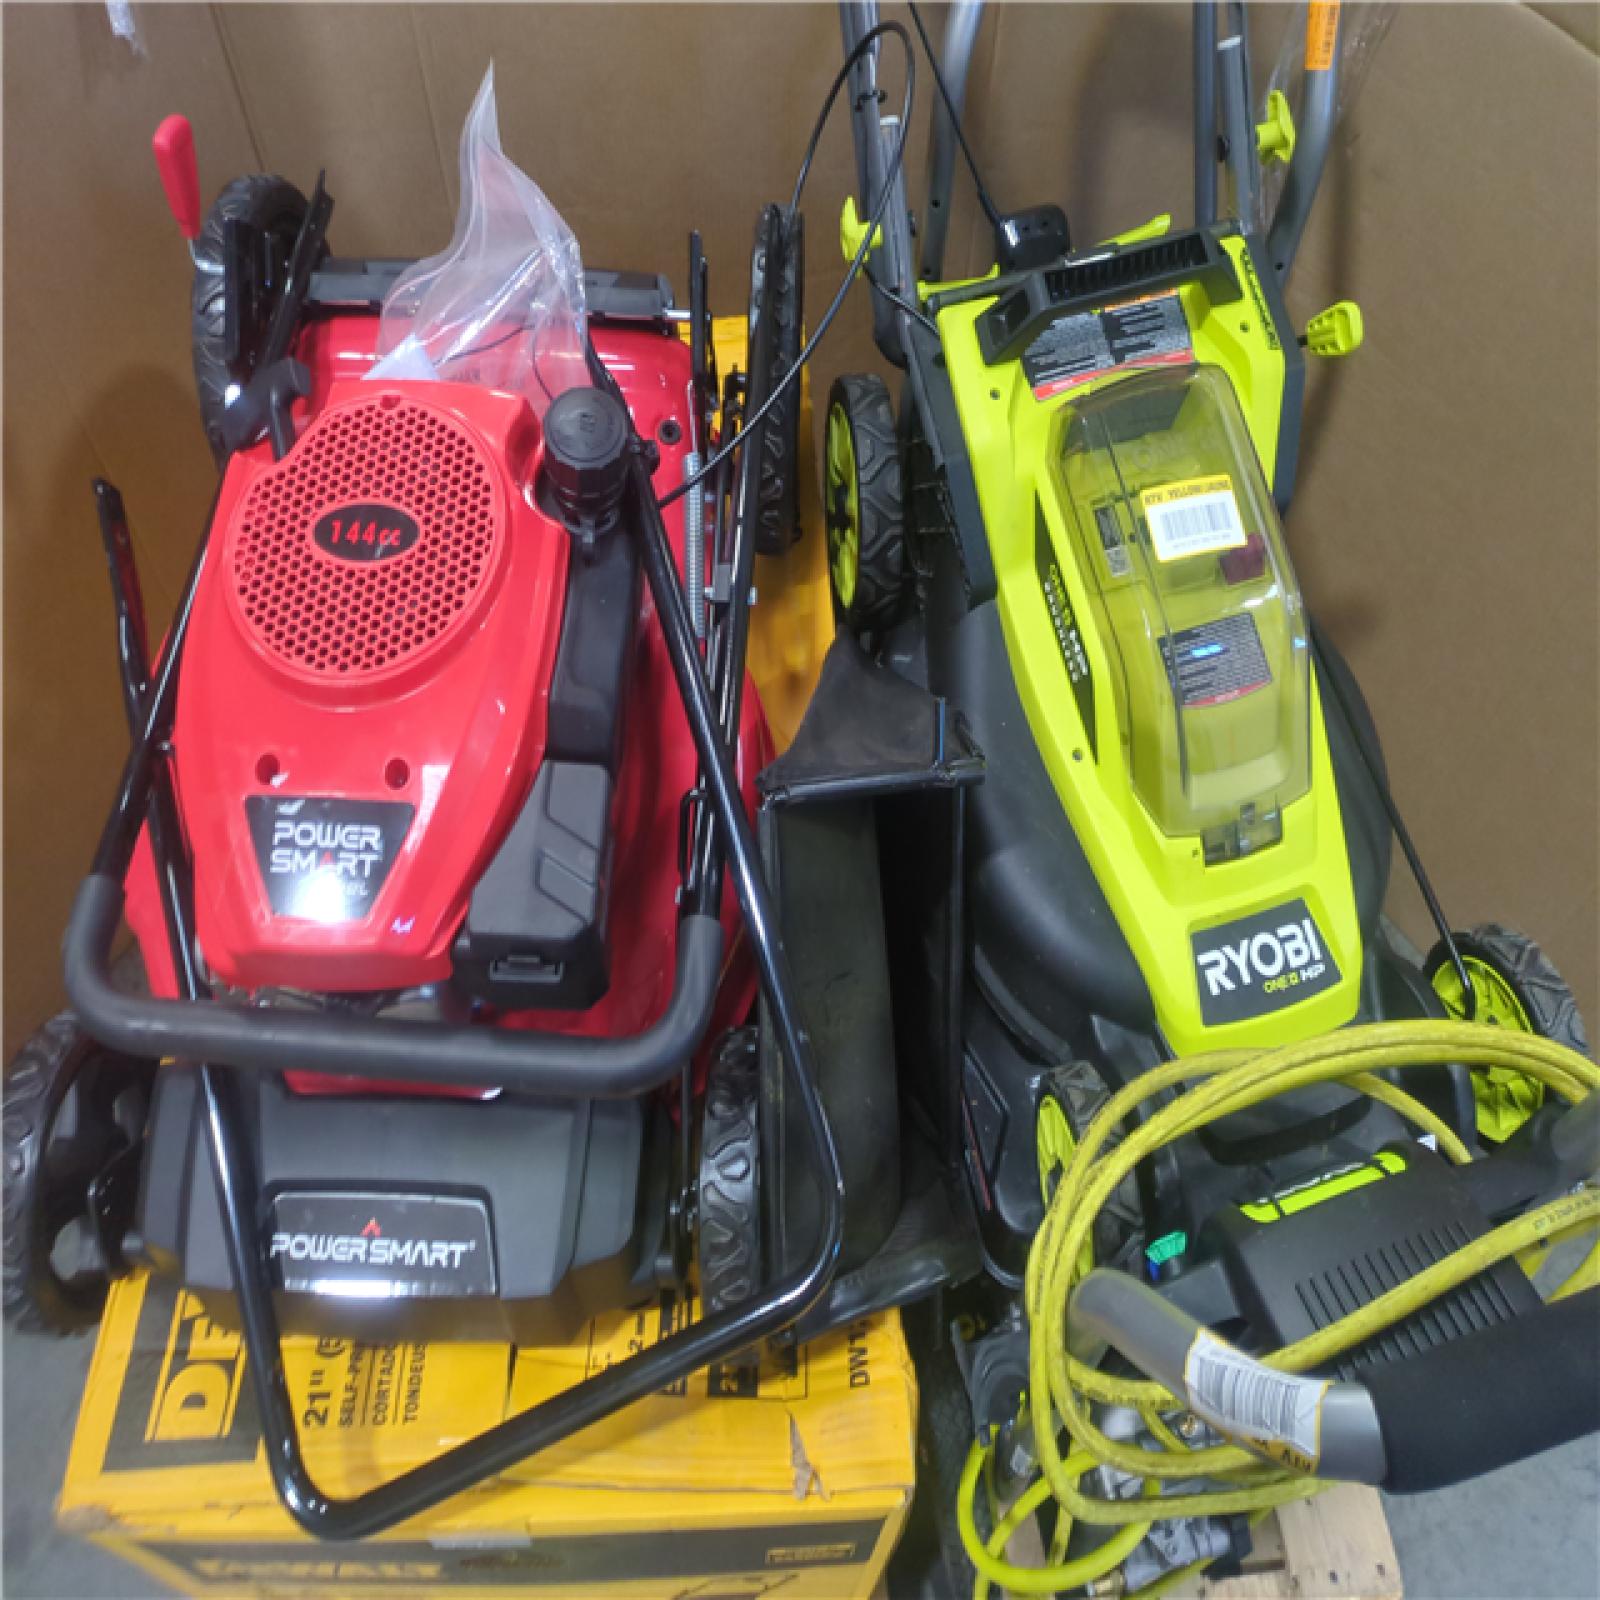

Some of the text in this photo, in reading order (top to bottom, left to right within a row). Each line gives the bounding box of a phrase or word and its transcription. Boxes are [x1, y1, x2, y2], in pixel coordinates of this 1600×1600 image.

[330, 518, 401, 546] 144cc
[272, 819, 383, 851] POWER
[269, 849, 384, 879] SMART
[1196, 917, 1323, 996] RYOBI
[269, 1231, 472, 1269] POWERSMART
